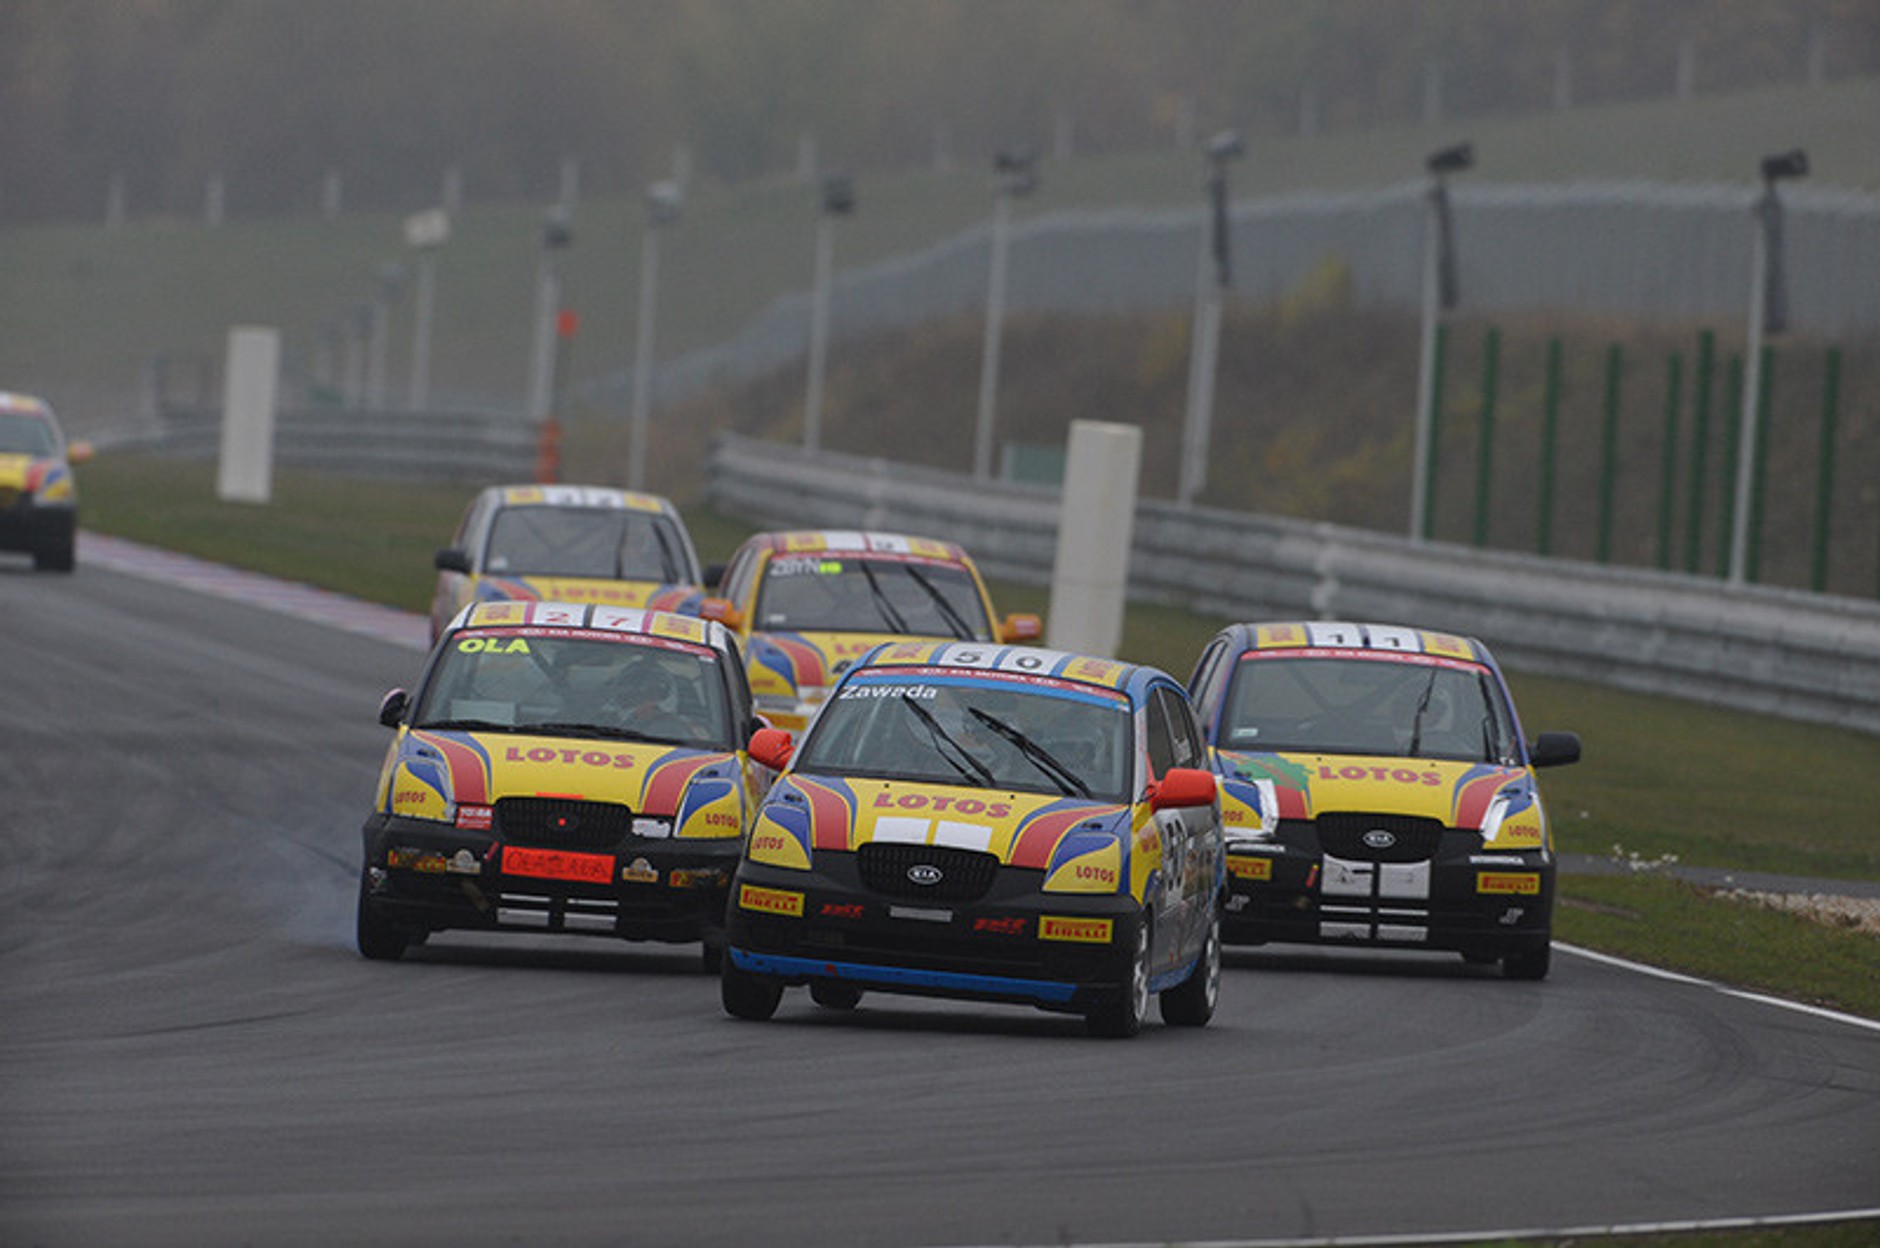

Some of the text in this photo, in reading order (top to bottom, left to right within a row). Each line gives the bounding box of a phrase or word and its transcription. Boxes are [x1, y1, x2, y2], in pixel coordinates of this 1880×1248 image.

[458, 638, 531, 655] OLA
[840, 684, 938, 700] Zawada
[505, 747, 635, 769] LOTOS
[1318, 765, 1442, 786] LOTOS
[873, 792, 1012, 818] LOTOS
[1075, 864, 1115, 884] LOTOS
[743, 889, 798, 912] PIRELLI
[1044, 920, 1108, 940] PIRELLI
